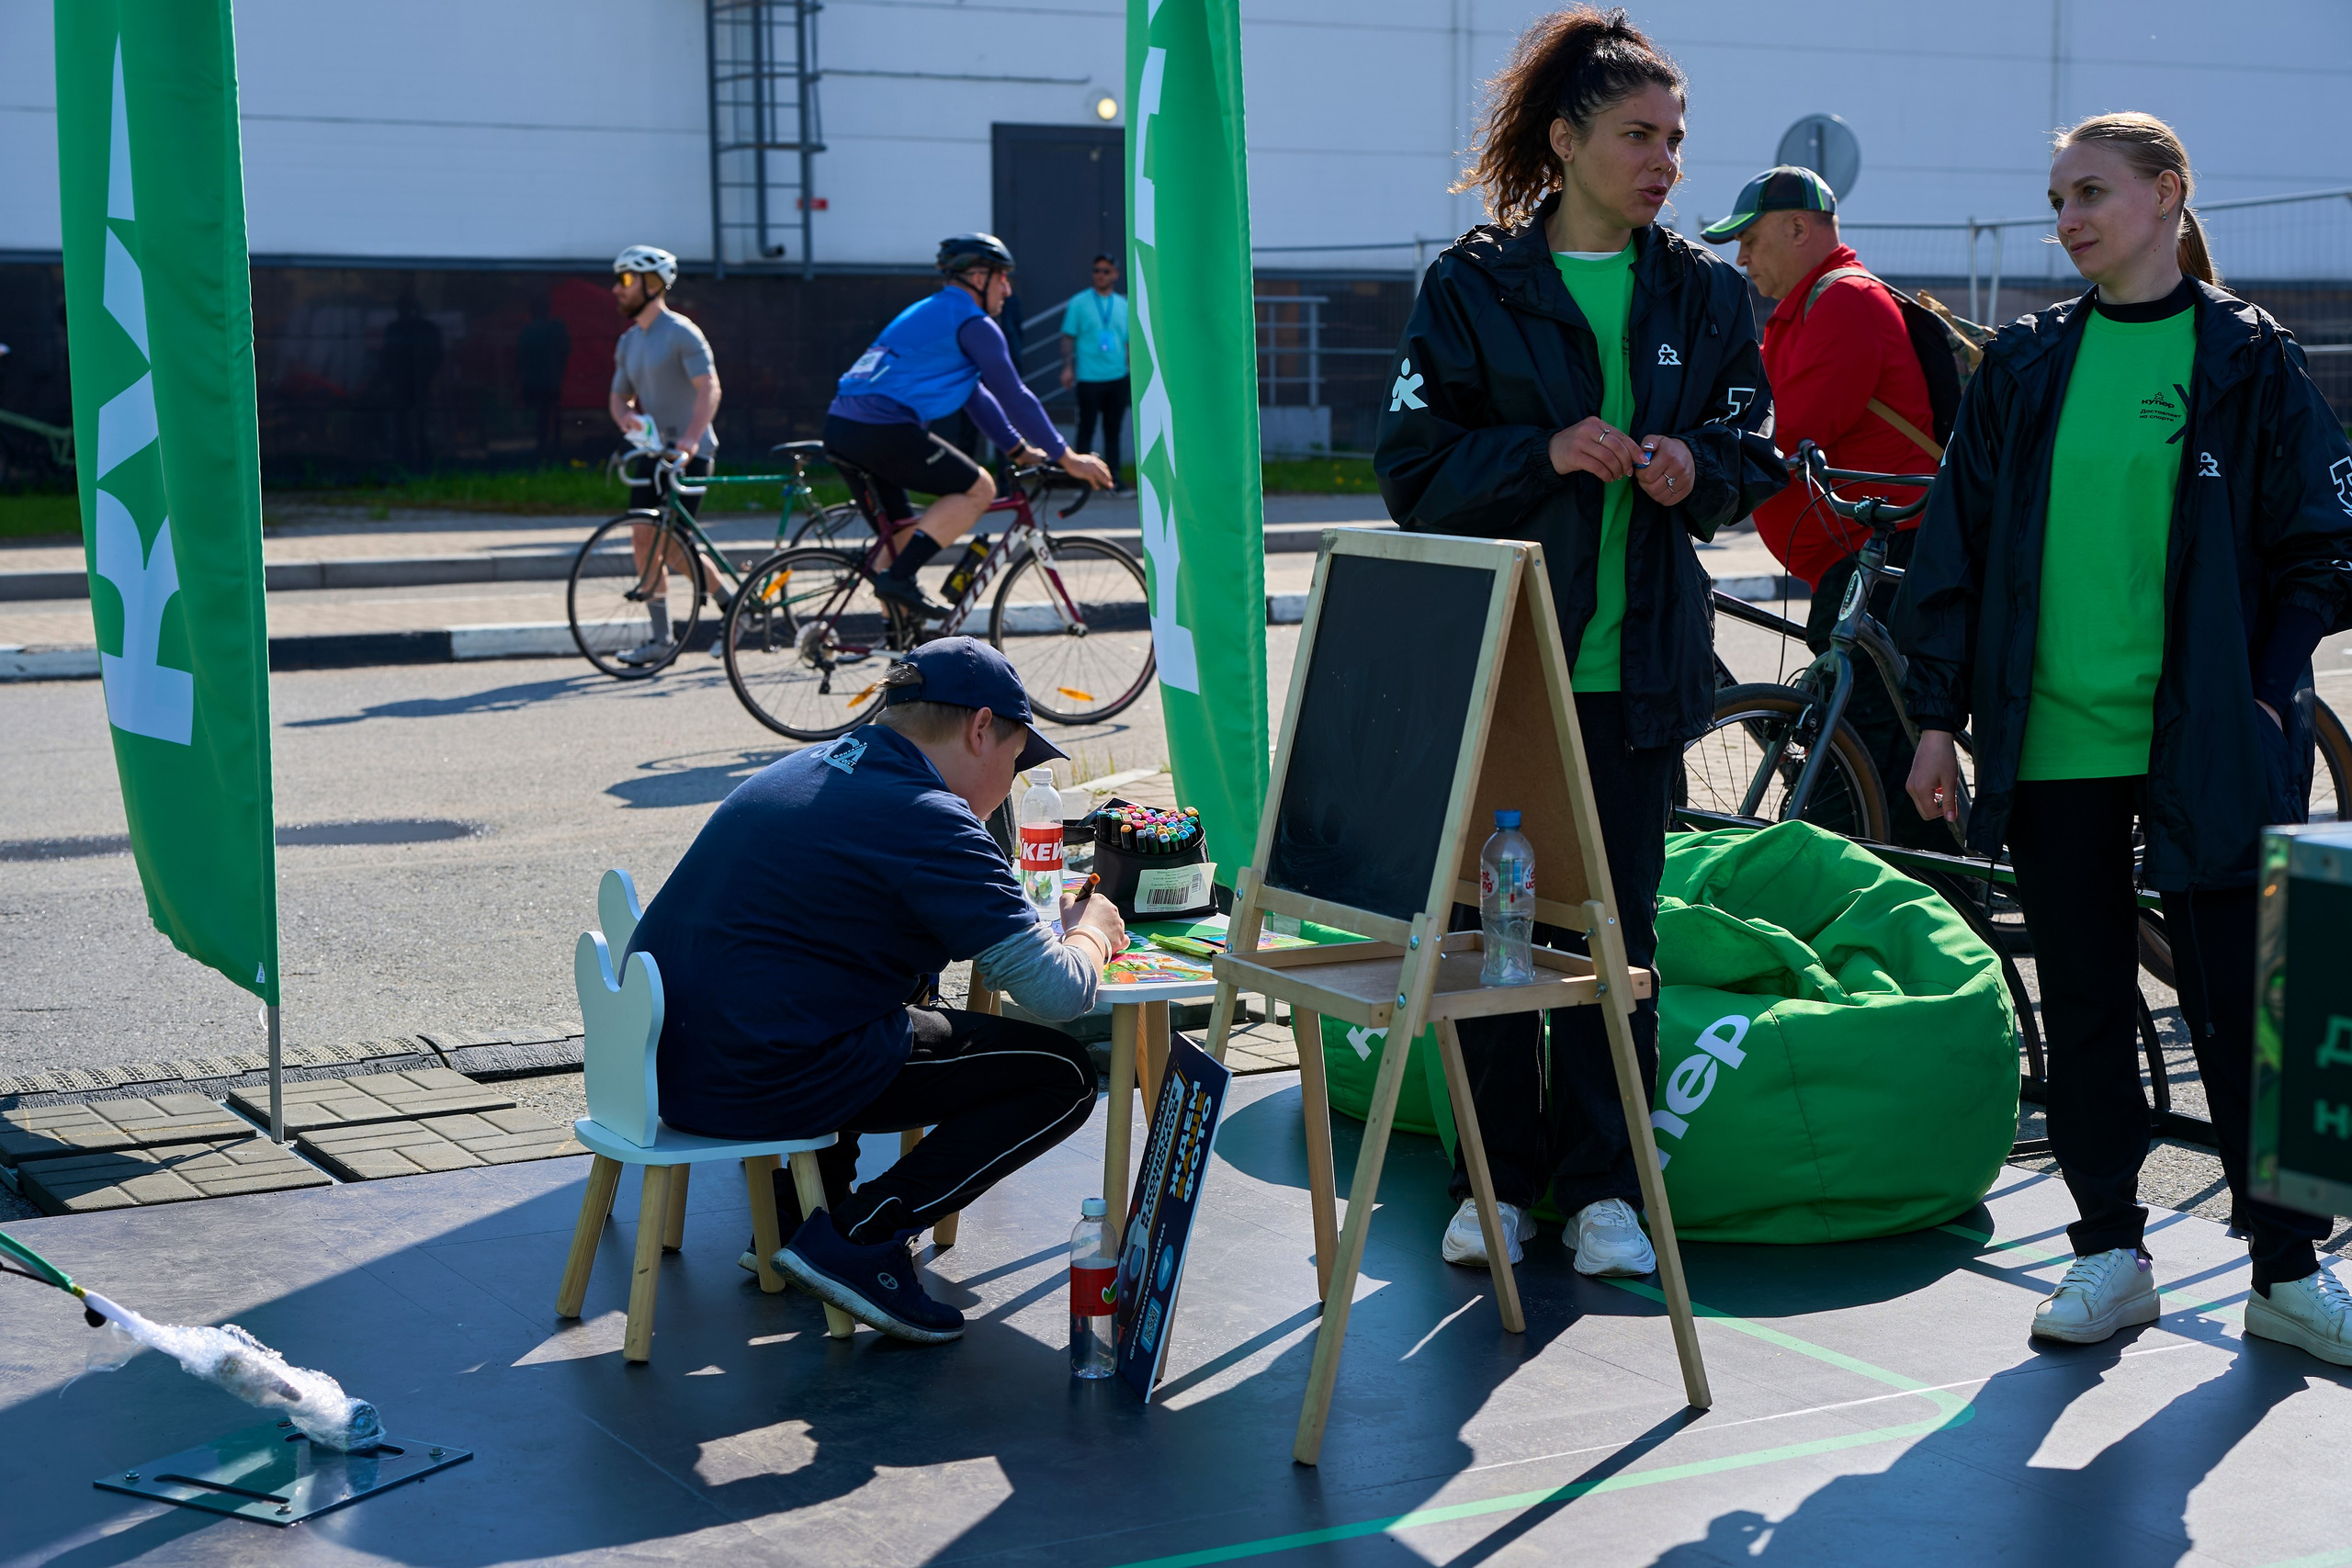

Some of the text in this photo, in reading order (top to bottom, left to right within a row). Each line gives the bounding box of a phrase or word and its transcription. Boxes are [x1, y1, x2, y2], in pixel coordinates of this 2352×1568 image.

[1142, 1080, 1171, 1188] УЧАСТВУЙТЕ
[1144, 1100, 1180, 1230] КОСТЮМОВ
[1146, 1087, 1178, 1205] КОНКУРСЕ
[1169, 1080, 1201, 1197] ЖДЕМ
[1176, 1091, 1206, 1199] ВАШЕ
[1183, 1096, 1212, 1202] ФОТО
